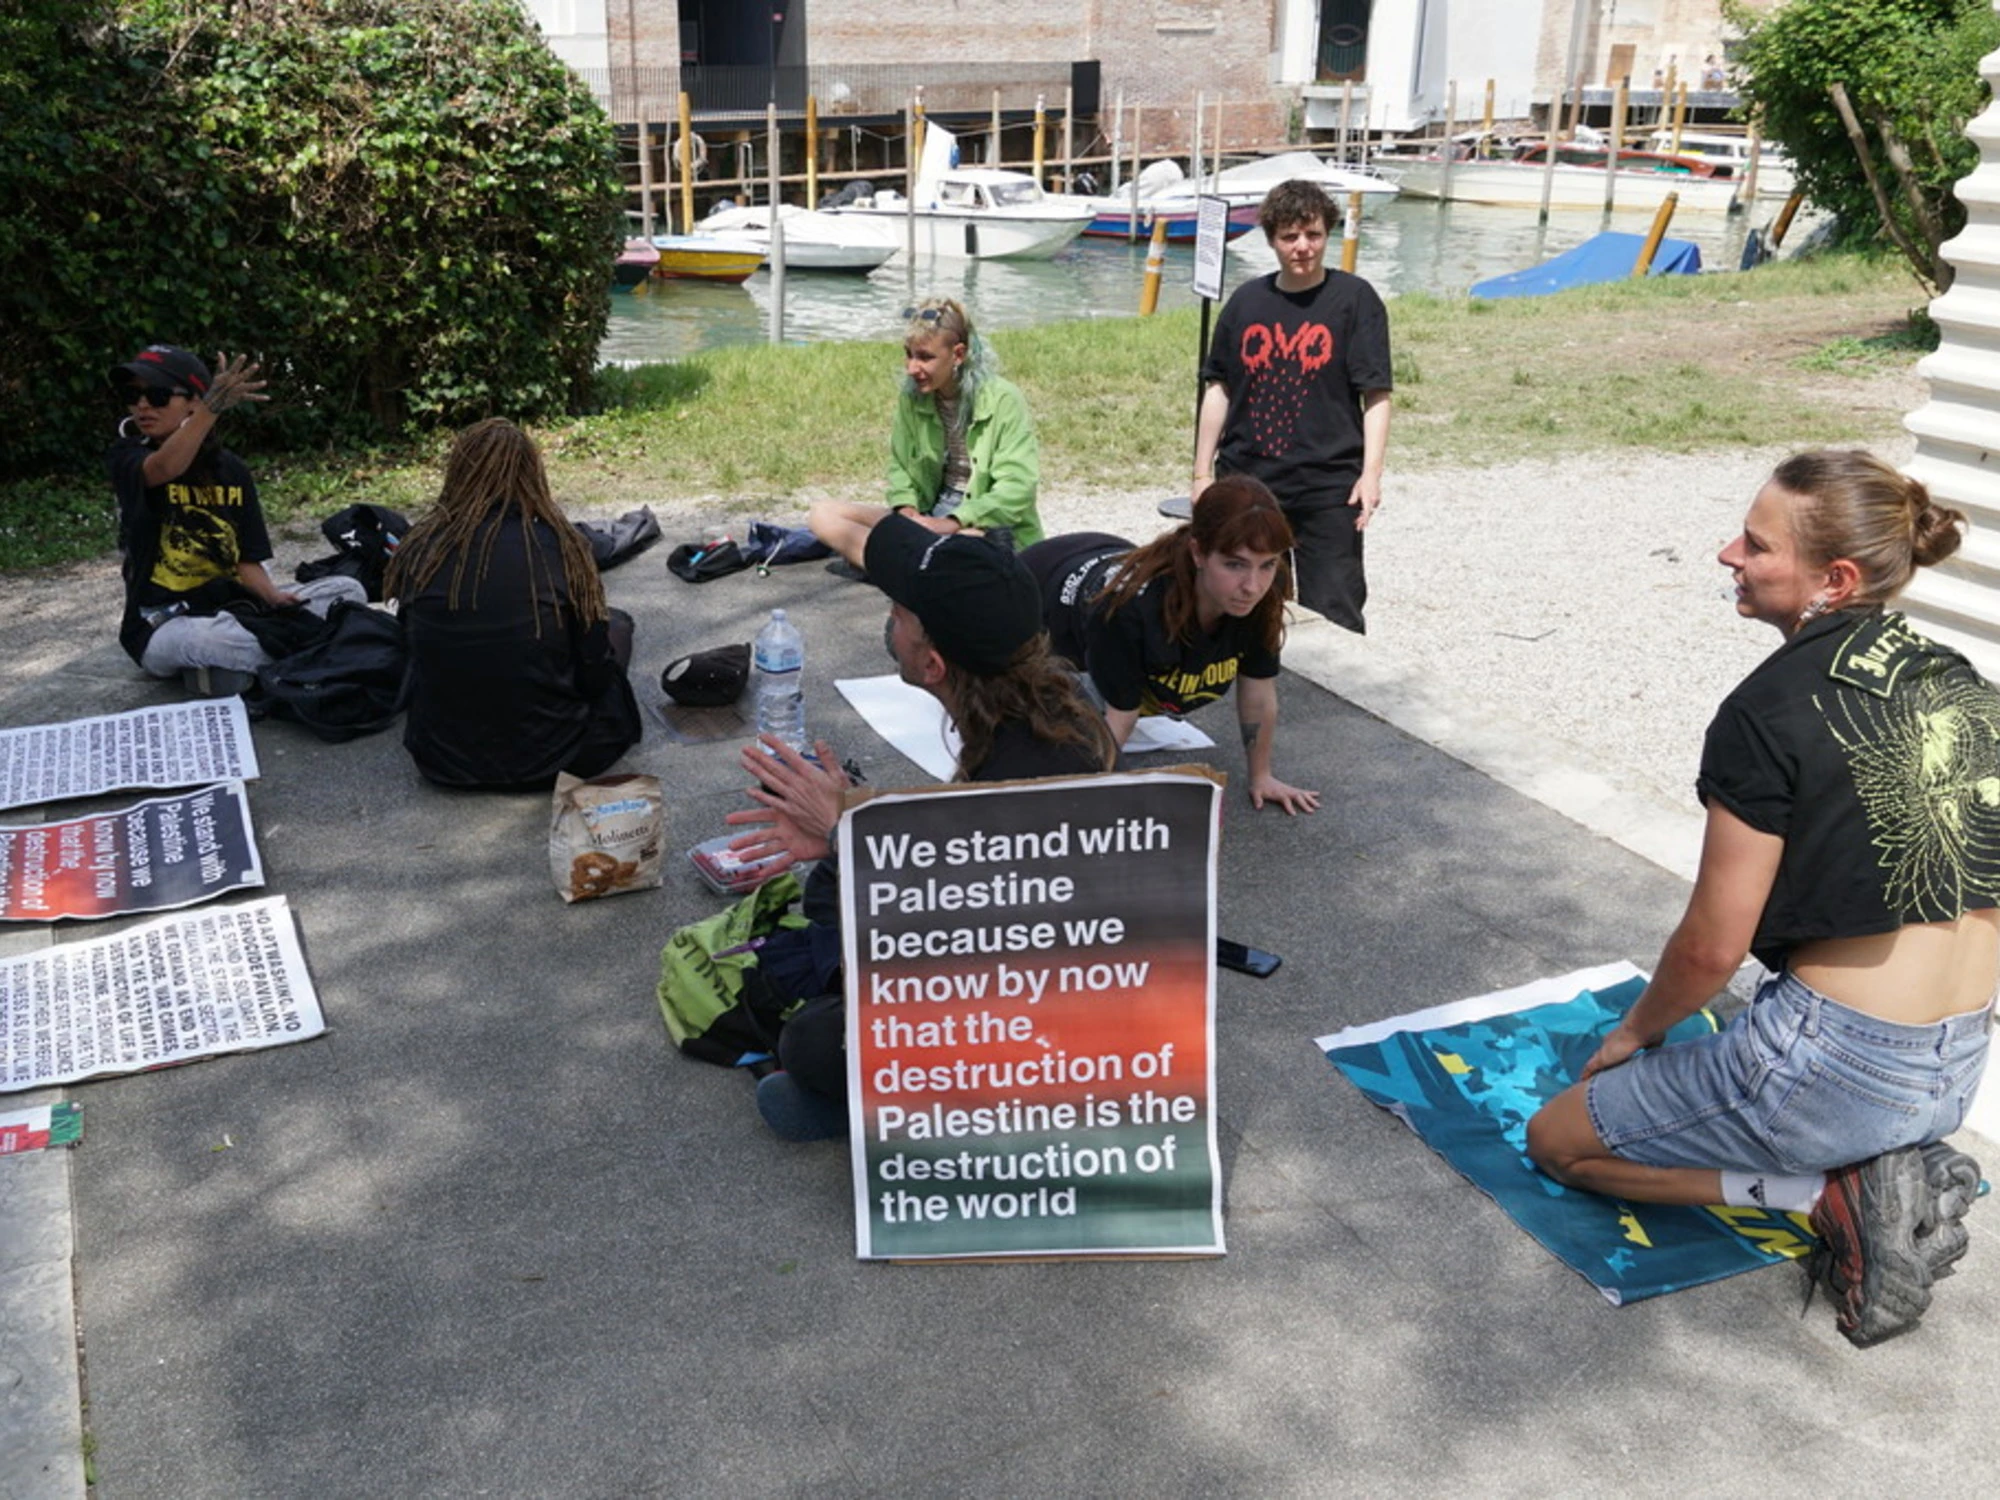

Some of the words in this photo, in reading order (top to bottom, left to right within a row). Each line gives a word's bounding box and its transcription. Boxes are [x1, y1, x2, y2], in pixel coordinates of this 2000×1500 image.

[191, 794, 216, 816] We
[61, 824, 84, 847] that
[94, 818, 118, 852] know
[127, 809, 150, 865] because
[160, 803, 187, 862] Palestine
[194, 816, 222, 853] stand
[865, 834, 937, 871] We
[945, 822, 1070, 866] stand
[1077, 817, 1170, 855] with
[25, 831, 51, 896] destruction
[61, 850, 84, 868] the
[89, 853, 119, 869] by
[200, 852, 226, 884] with
[97, 872, 117, 898] now
[131, 866, 152, 886] we
[22, 897, 50, 910] of
[869, 872, 1074, 916] Palestine
[162, 923, 179, 941] WE
[199, 916, 218, 944] WITH
[217, 912, 234, 931] WE
[126, 935, 143, 959] AND
[205, 945, 223, 964] THE
[221, 931, 243, 965] STAND
[870, 922, 1056, 961] because
[1065, 916, 1125, 946] we
[107, 940, 132, 1010] DESTRUCTION
[129, 959, 148, 984] THE
[165, 941, 187, 987] DEMAND
[230, 964, 245, 979] IN
[235, 910, 265, 973] GENOCIDE
[250, 971, 282, 1037] PAVILION.
[253, 906, 271, 926] NO
[281, 1009, 301, 1033] NO
[153, 984, 172, 1010] WAR
[174, 989, 191, 1006] AN
[209, 966, 232, 1005] STRIKE
[871, 972, 989, 1005] know
[998, 963, 1050, 1004] by
[1059, 961, 1149, 993] now
[116, 1010, 133, 1025] OF
[132, 985, 160, 1061] SYSTEMATIC
[177, 1007, 197, 1032] END
[218, 1006, 235, 1019] IN
[232, 978, 262, 1041] SOLIDARITY
[118, 1026, 136, 1049] LIFE
[182, 1033, 200, 1051] TO
[221, 1021, 241, 1044] THE
[871, 1015, 957, 1049] that
[964, 1011, 1033, 1044] the
[873, 1051, 1122, 1094] destruction
[1130, 1043, 1175, 1078] of
[877, 1098, 1076, 1142] Palestine
[1085, 1094, 1121, 1128] is
[1128, 1090, 1196, 1124] the
[879, 1142, 1127, 1181] destruction
[1135, 1135, 1176, 1171] of
[880, 1190, 949, 1223] the
[957, 1187, 1077, 1220] world
